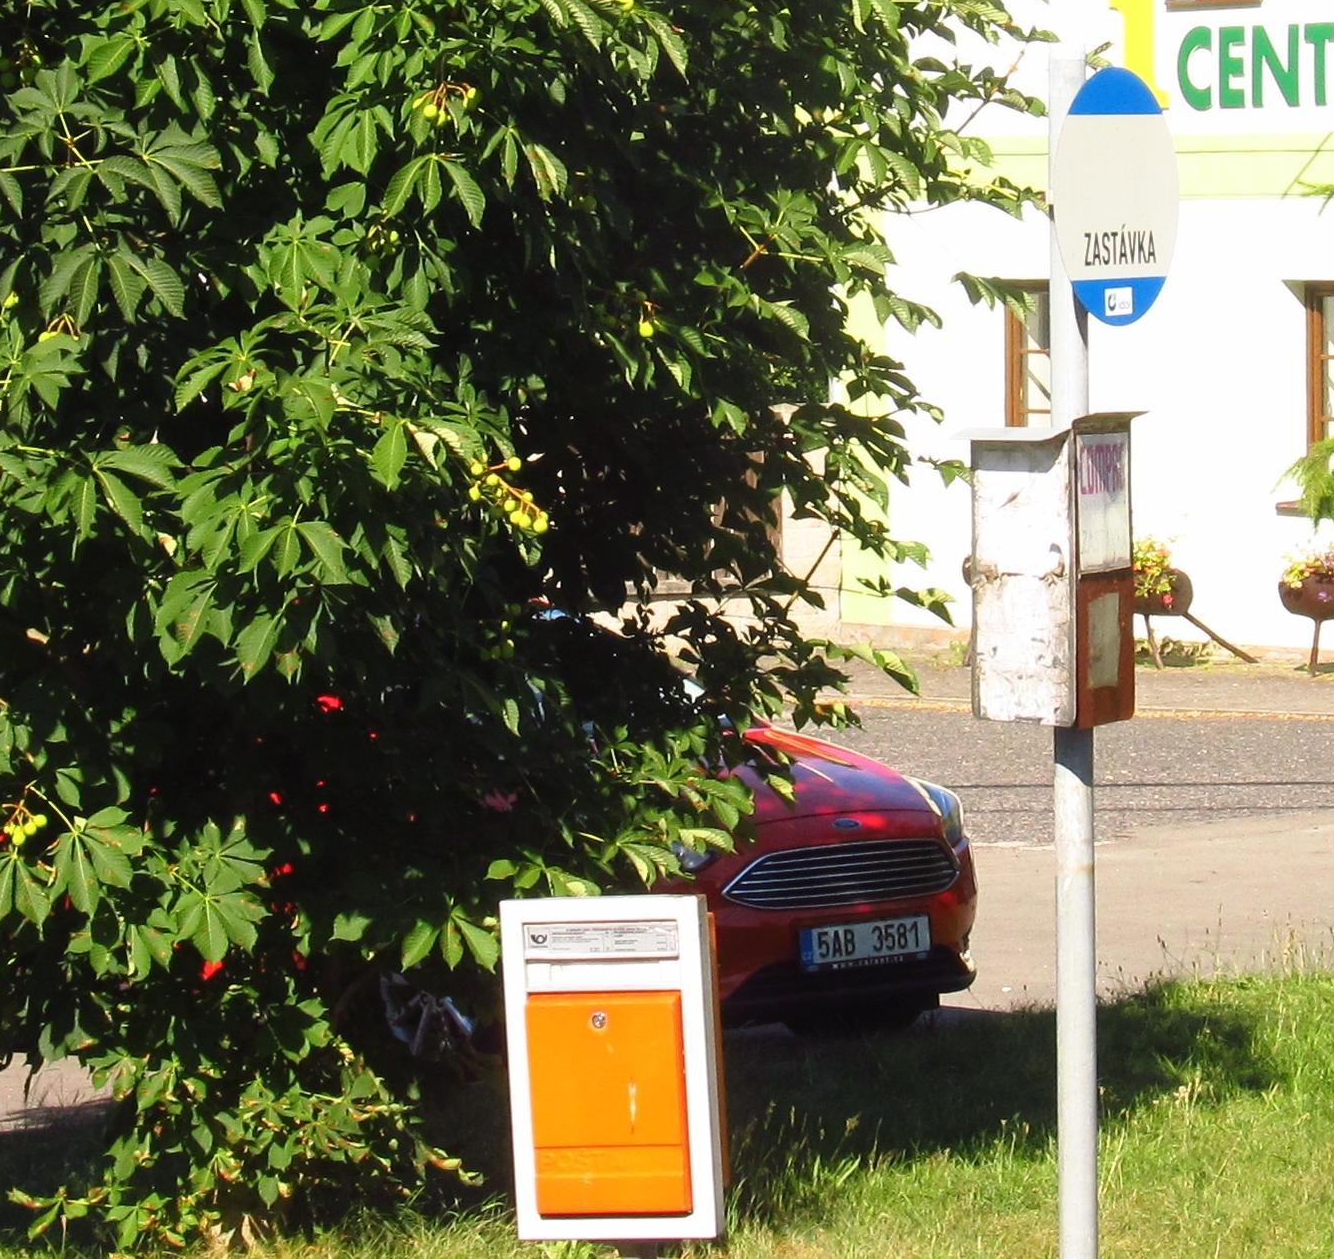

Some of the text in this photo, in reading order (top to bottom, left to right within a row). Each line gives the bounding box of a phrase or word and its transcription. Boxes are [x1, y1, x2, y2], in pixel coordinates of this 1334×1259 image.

[1084, 223, 1156, 267] ZASTÁVKA
[818, 921, 919, 958] 5AB 3581
